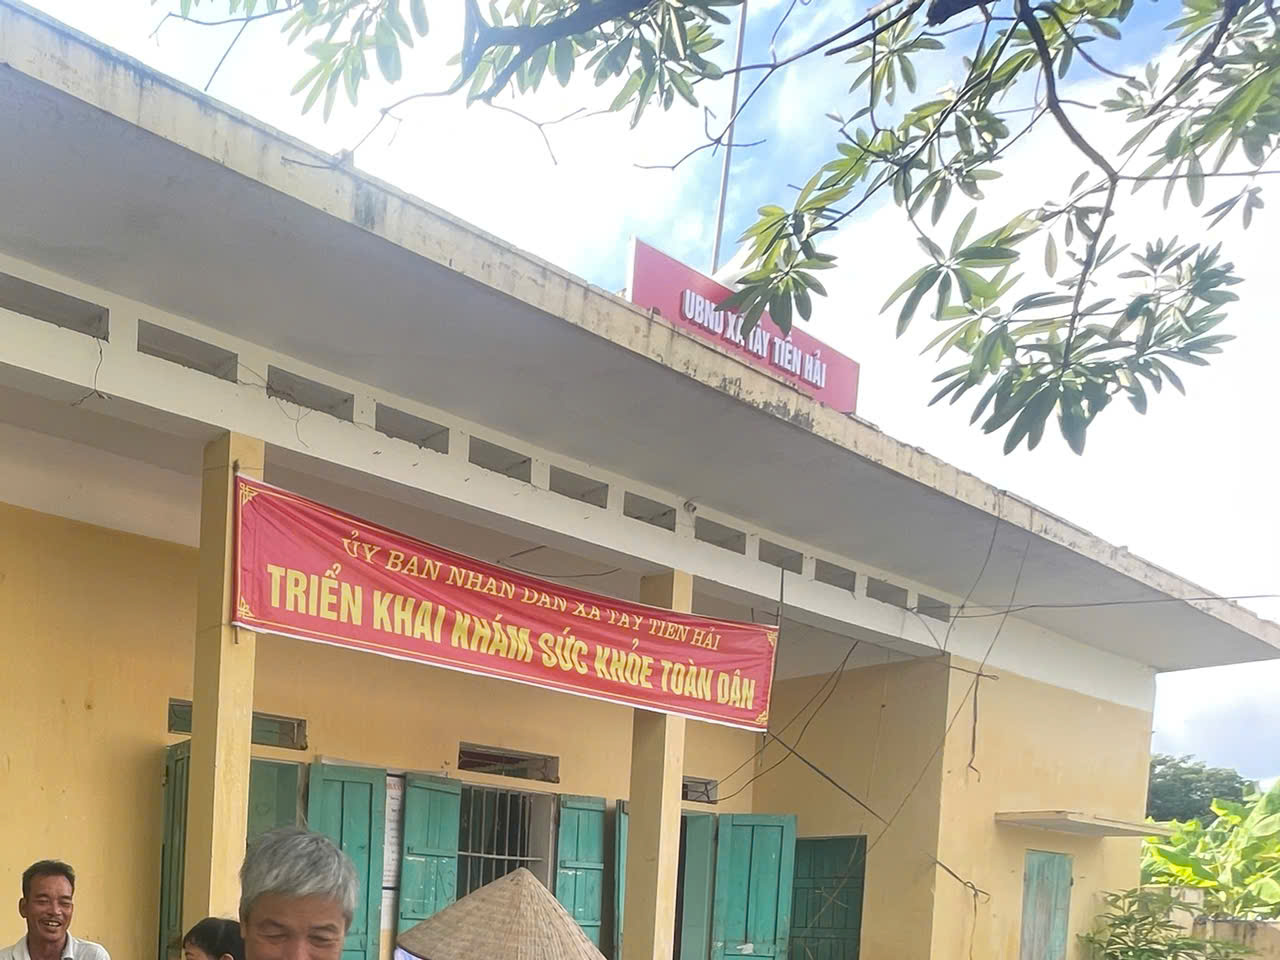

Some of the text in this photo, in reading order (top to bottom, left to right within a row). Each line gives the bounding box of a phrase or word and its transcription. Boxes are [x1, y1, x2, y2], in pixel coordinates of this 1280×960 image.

[685, 289, 724, 334] UBND
[804, 350, 827, 389] HẢI
[342, 530, 381, 564] ỦY
[385, 550, 444, 582] BAN
[266, 563, 756, 710] TRIỂN KHAI KHÁM SỨC KHỎE TOÀN DÂN
